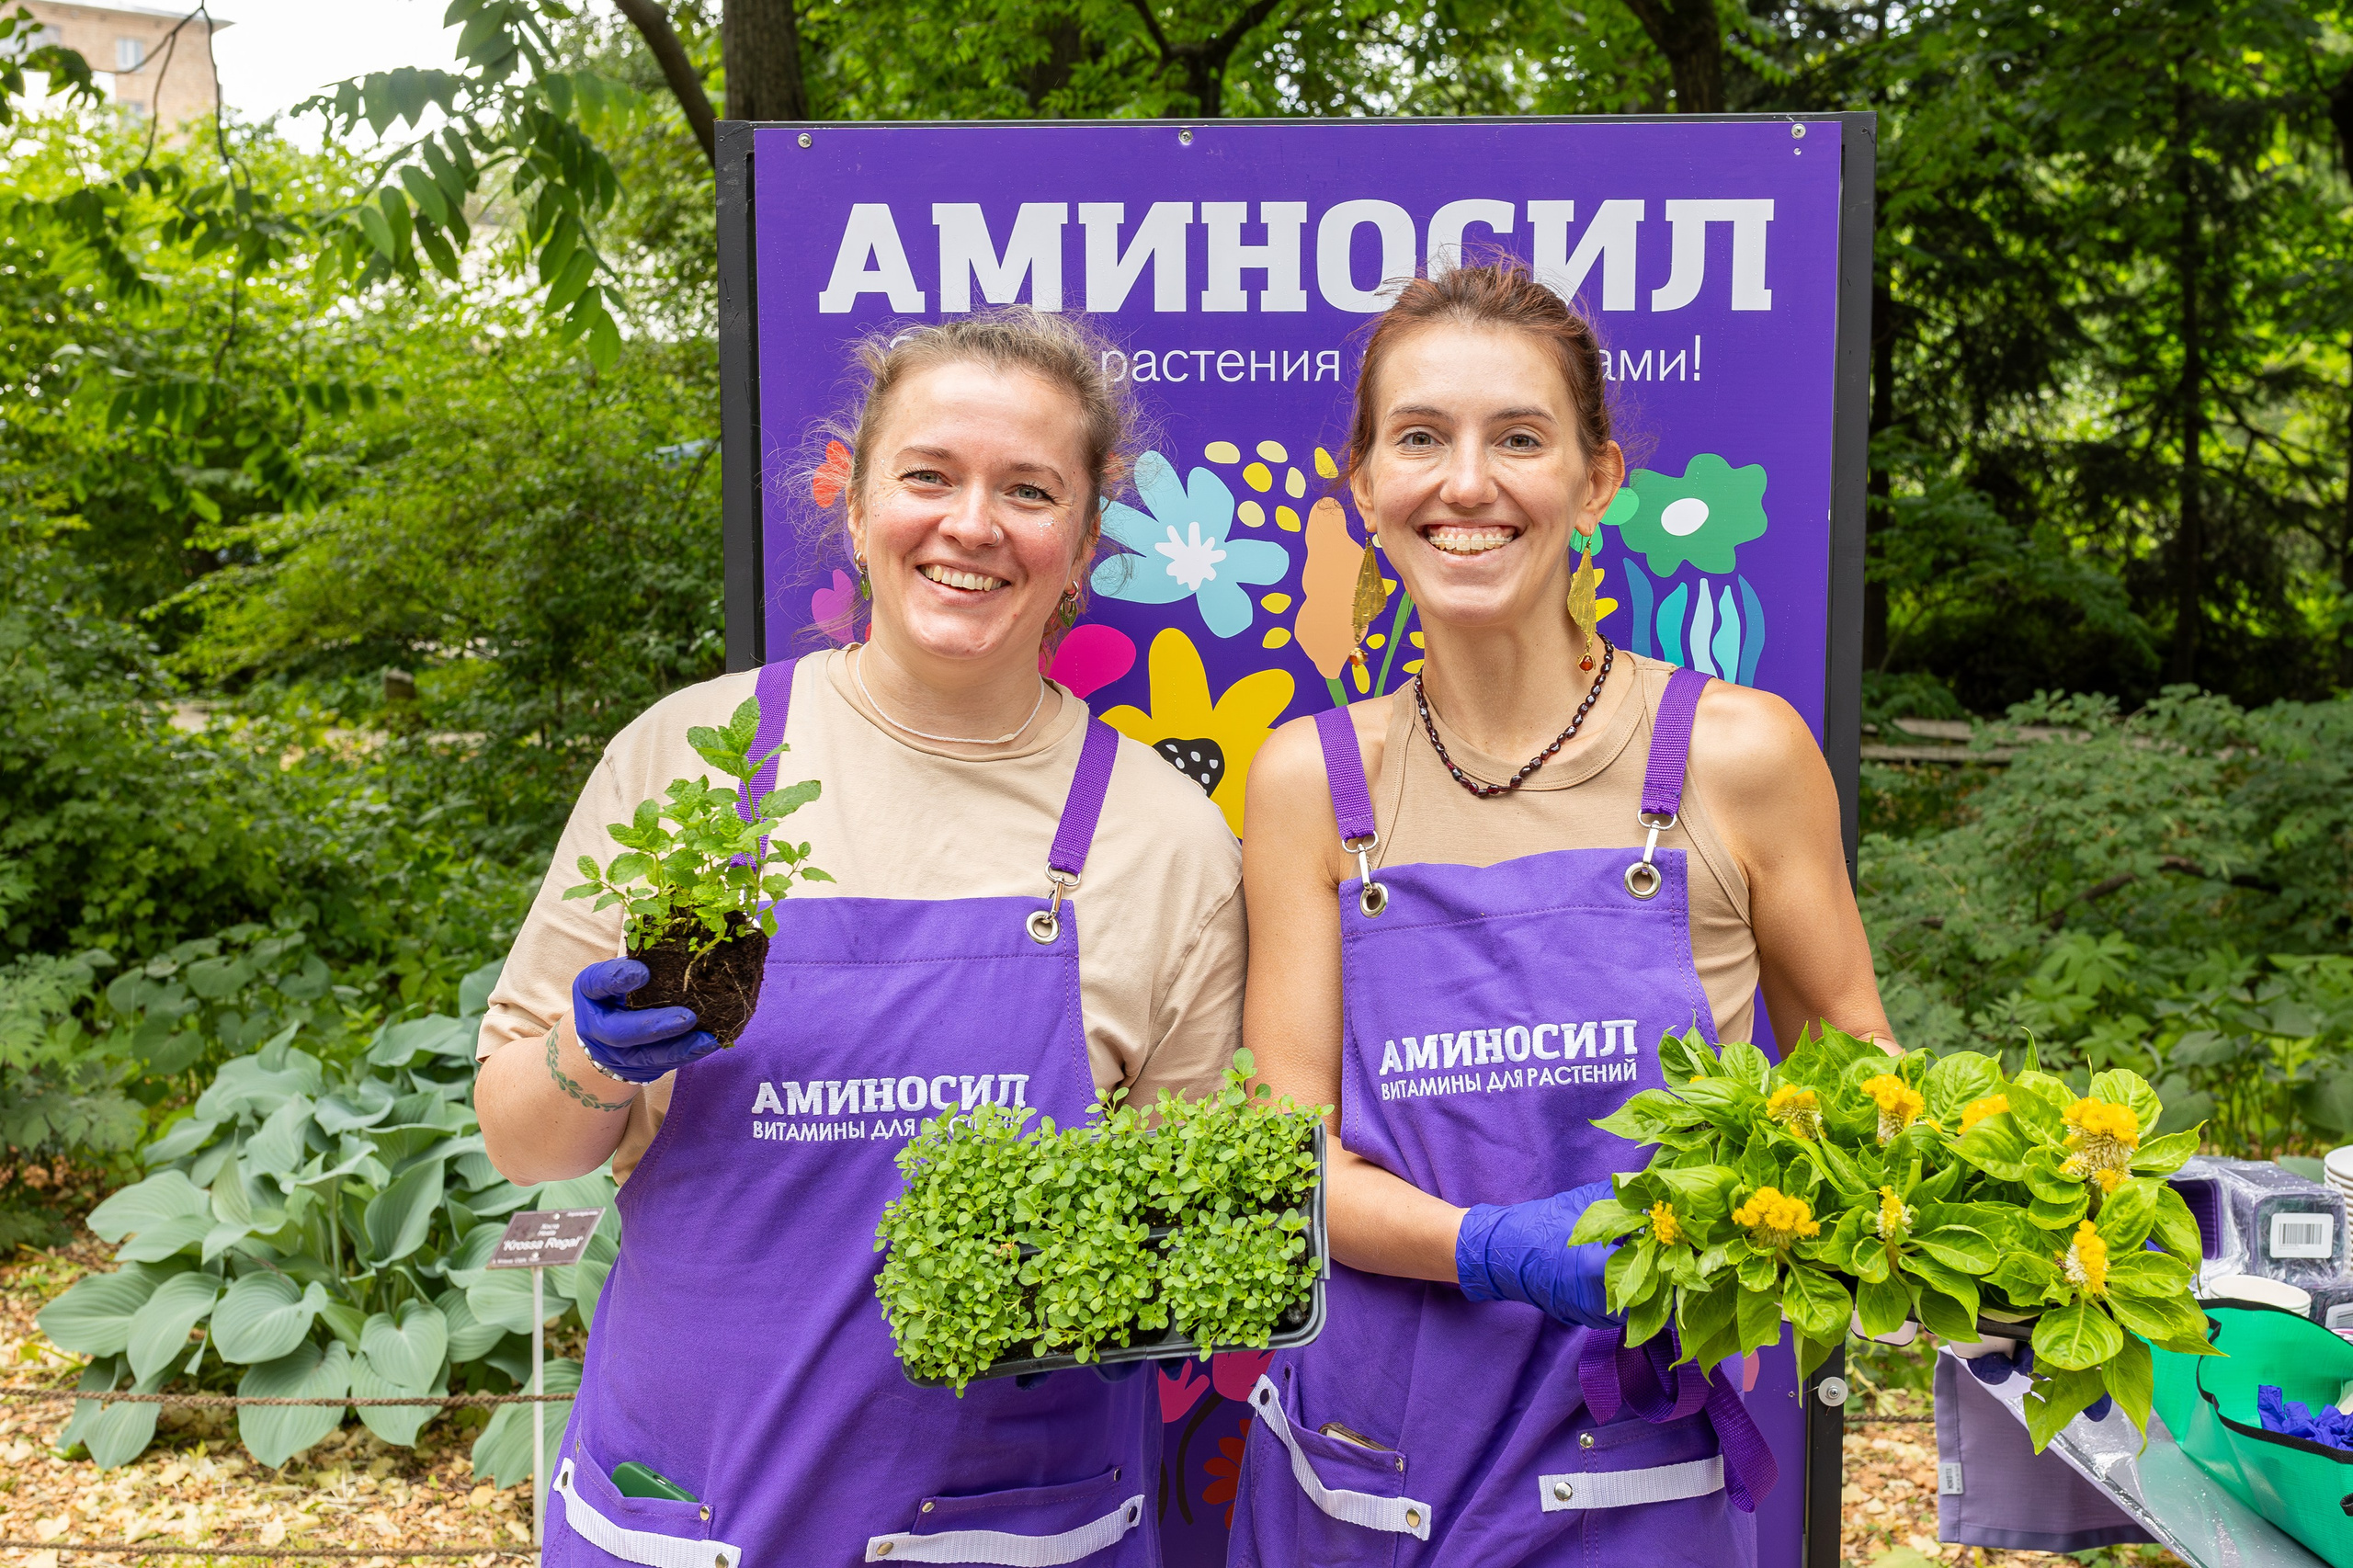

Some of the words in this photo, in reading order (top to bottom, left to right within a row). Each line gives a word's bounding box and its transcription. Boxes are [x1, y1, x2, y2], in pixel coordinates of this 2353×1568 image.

[819, 198, 1775, 314] АМИНОСИЛ
[1379, 1019, 1638, 1076] АМИНОСИЛ
[751, 1074, 1030, 1116] АМИНОСИЛ
[1381, 1073, 1482, 1102] ВИТАМИНЫ
[1486, 1069, 1524, 1094] ДЛЯ
[1527, 1058, 1638, 1088] РАСТЕНИЙ
[752, 1119, 866, 1142] ВИТАМИНЫ
[870, 1118, 916, 1141] ДЛЯ
